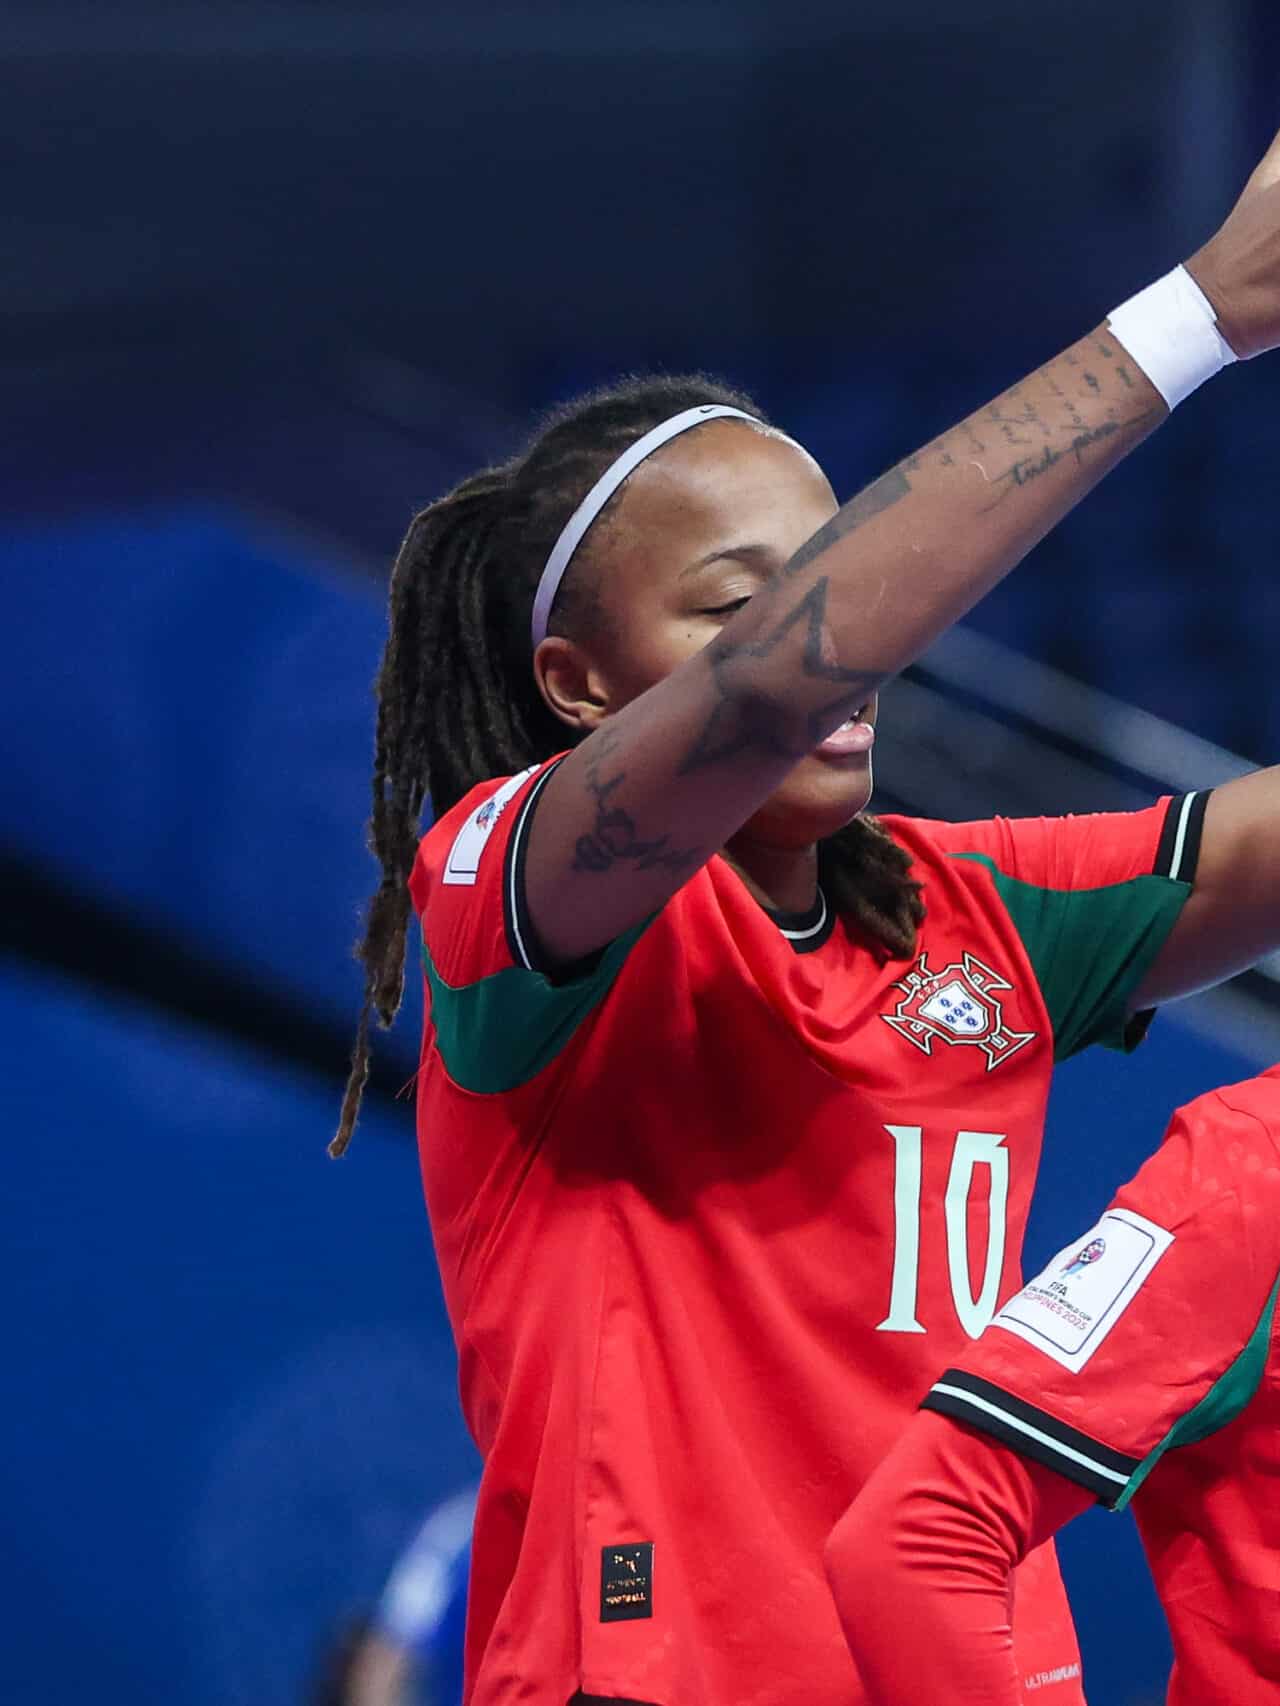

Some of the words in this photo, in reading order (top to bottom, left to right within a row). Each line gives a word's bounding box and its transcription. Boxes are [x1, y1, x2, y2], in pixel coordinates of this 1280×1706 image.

[875, 1123, 1009, 1341] 10
[1048, 1281, 1068, 1296] FIFA
[1062, 1310, 1088, 1331] 2025
[1079, 1311, 1092, 1321] CUP
